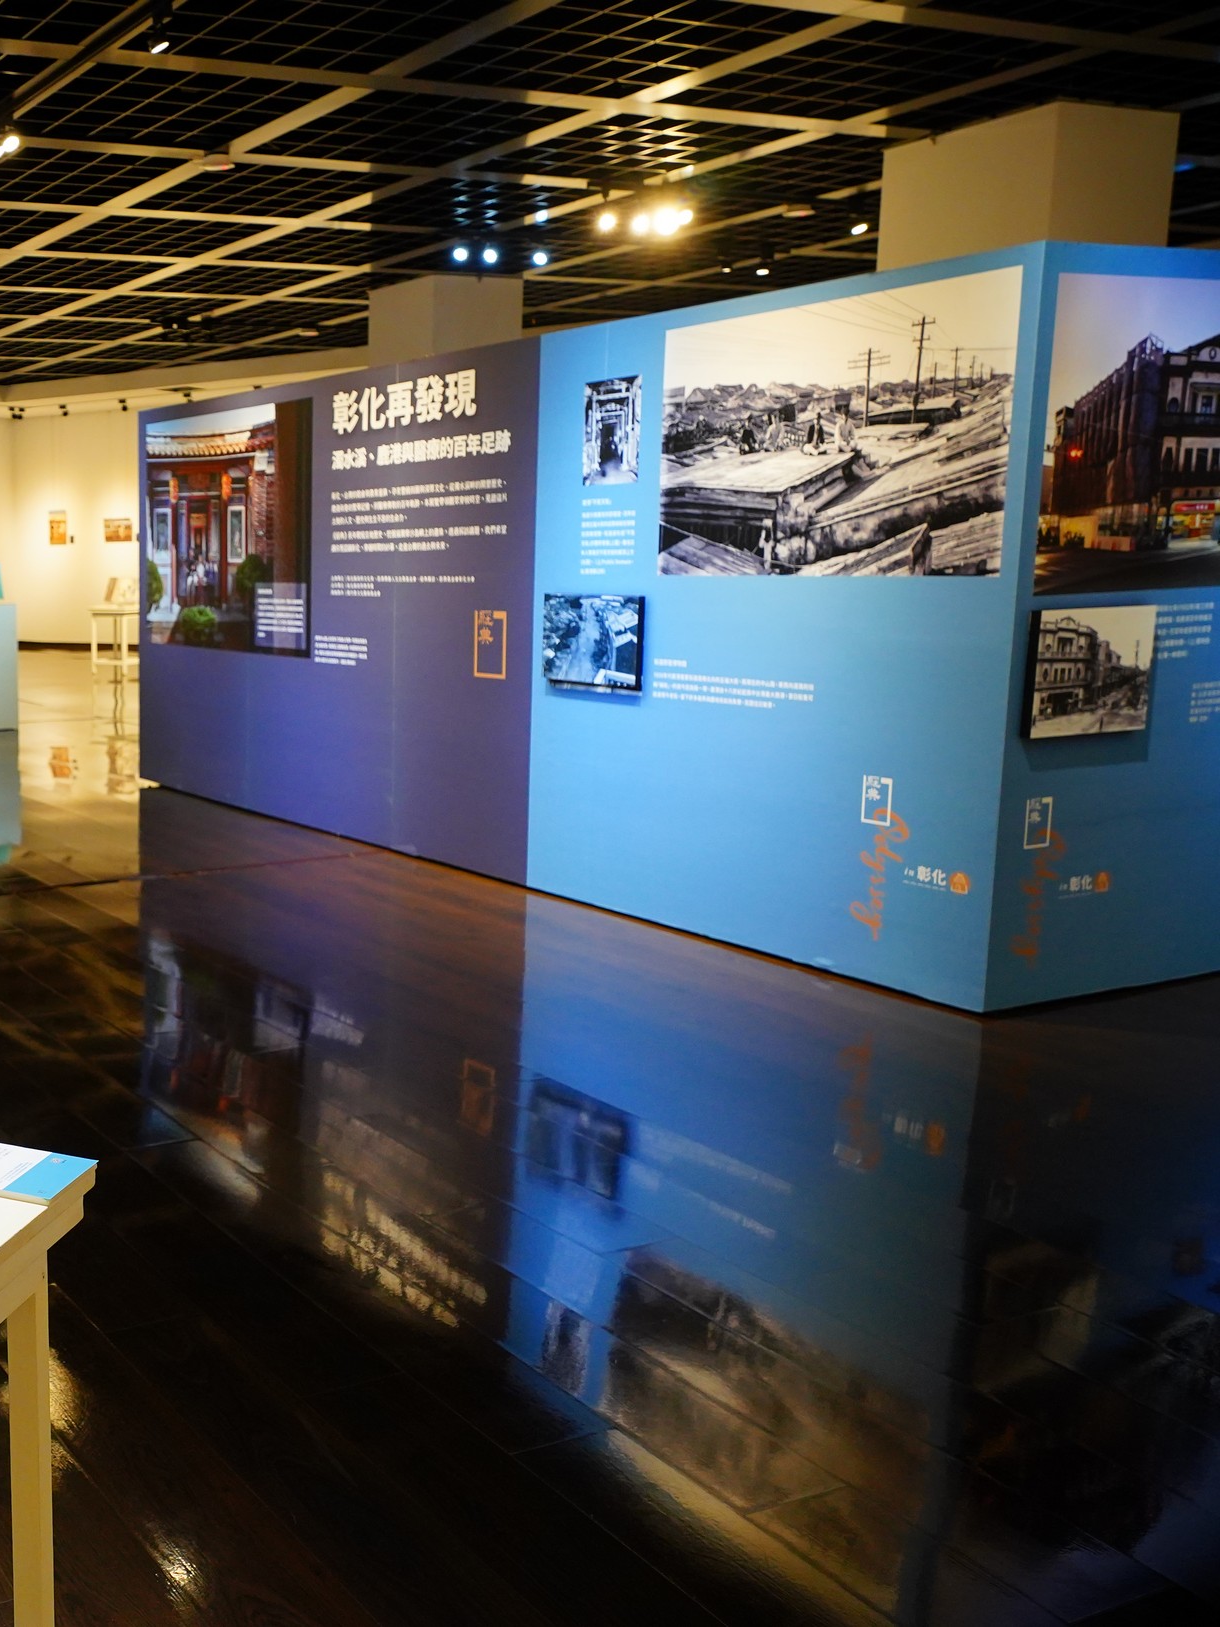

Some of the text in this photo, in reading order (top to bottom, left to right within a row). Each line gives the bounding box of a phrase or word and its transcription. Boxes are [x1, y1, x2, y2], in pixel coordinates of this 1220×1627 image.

[332, 369, 477, 435] 彰化再發現
[917, 865, 947, 886] 彰化
